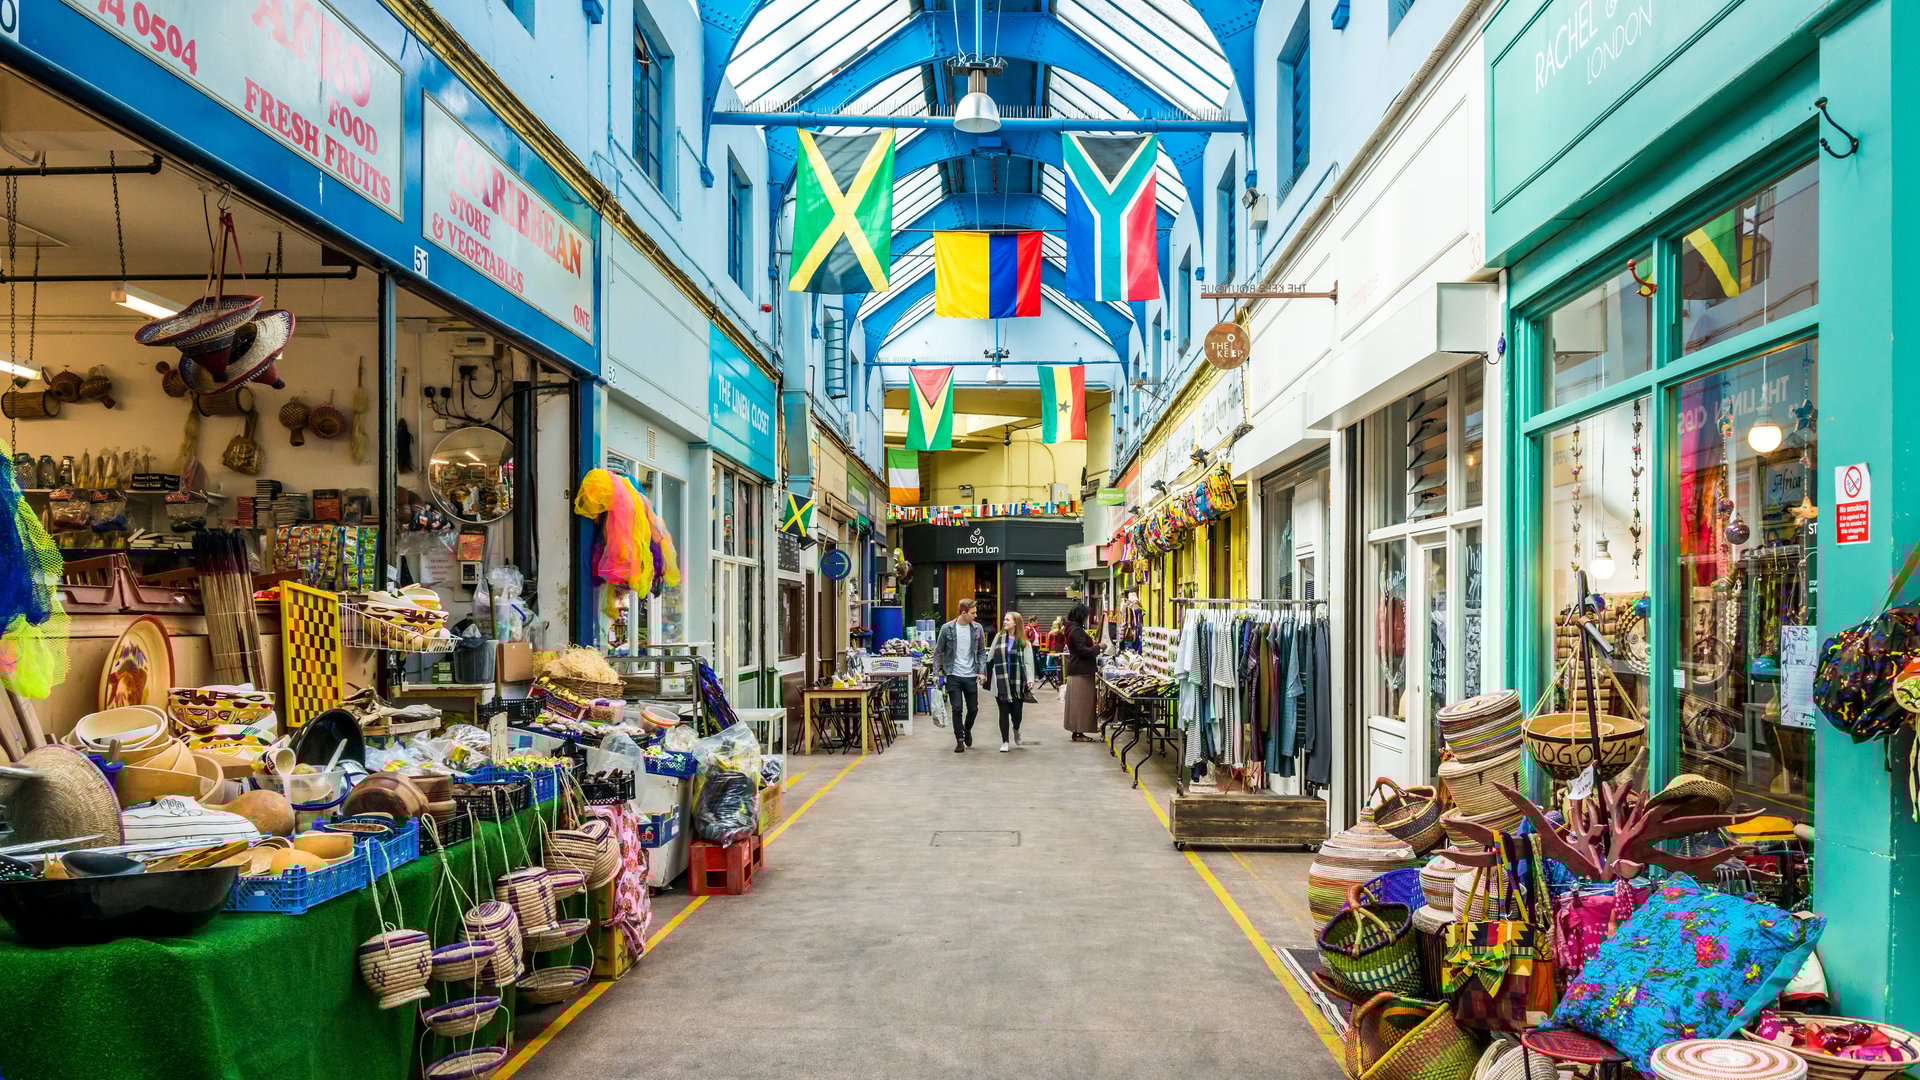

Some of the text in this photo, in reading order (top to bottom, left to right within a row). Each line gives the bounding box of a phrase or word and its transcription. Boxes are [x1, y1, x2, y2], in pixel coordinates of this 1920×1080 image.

[132, 1, 197, 76] 0504
[1536, 0, 1598, 94] RACHEL
[1587, 0, 1652, 85] LONDON
[244, 76, 391, 205] FRESH FRUITS
[327, 95, 378, 155] FOOD
[449, 189, 491, 241] STORE
[455, 137, 583, 280] CARIBBEAN
[414, 249, 429, 277] 51
[432, 212, 524, 294] & VEGETABLES
[573, 304, 591, 333] ONE
[1210, 342, 1229, 350] THE
[1217, 350, 1243, 358] KEEP
[607, 366, 617, 385] 52
[718, 373, 769, 436] THE LINEN CLOSET
[1847, 504, 1867, 513] smoking
[985, 545, 1000, 554] lan
[1016, 568, 1025, 576] 18
